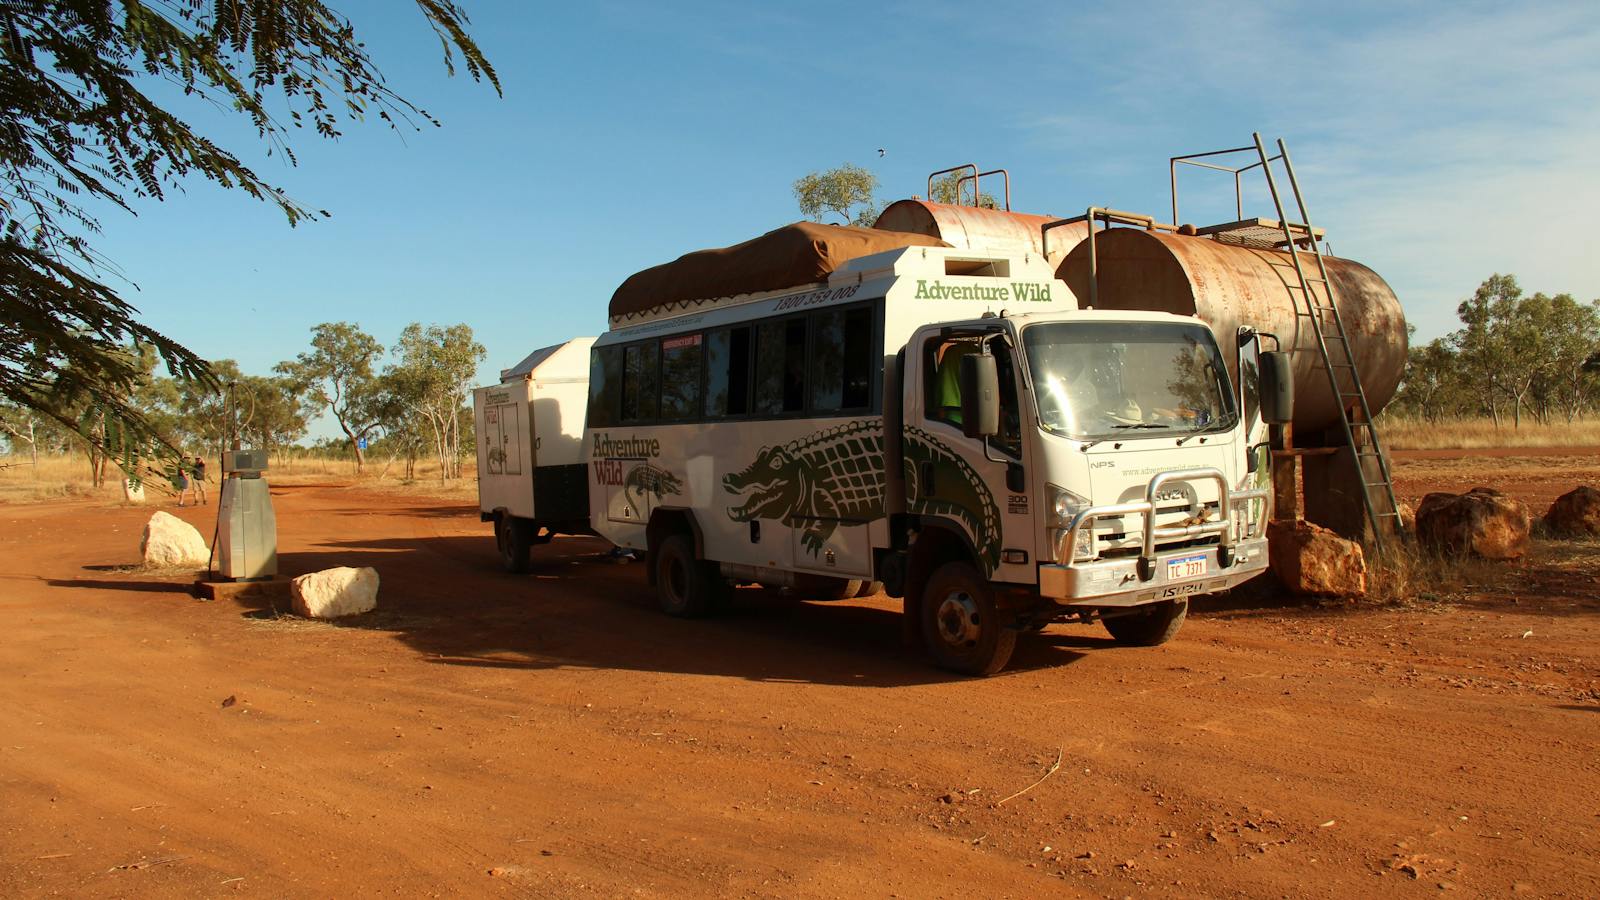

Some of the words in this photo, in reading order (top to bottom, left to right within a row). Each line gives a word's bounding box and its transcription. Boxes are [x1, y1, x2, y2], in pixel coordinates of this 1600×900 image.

[773, 294, 807, 311] 1800
[804, 288, 832, 305] 359
[831, 284, 861, 301] 008
[915, 280, 1009, 301] Adventure
[1010, 282, 1052, 302] Wild
[592, 433, 660, 457] Adventure
[1090, 461, 1115, 469] NPS
[594, 461, 624, 486] Wild
[1007, 495, 1028, 503] 300
[1155, 488, 1189, 501] SUZU
[1170, 565, 1181, 578] TC
[1186, 562, 1202, 576] 7371
[1163, 583, 1203, 597] ISUZU
